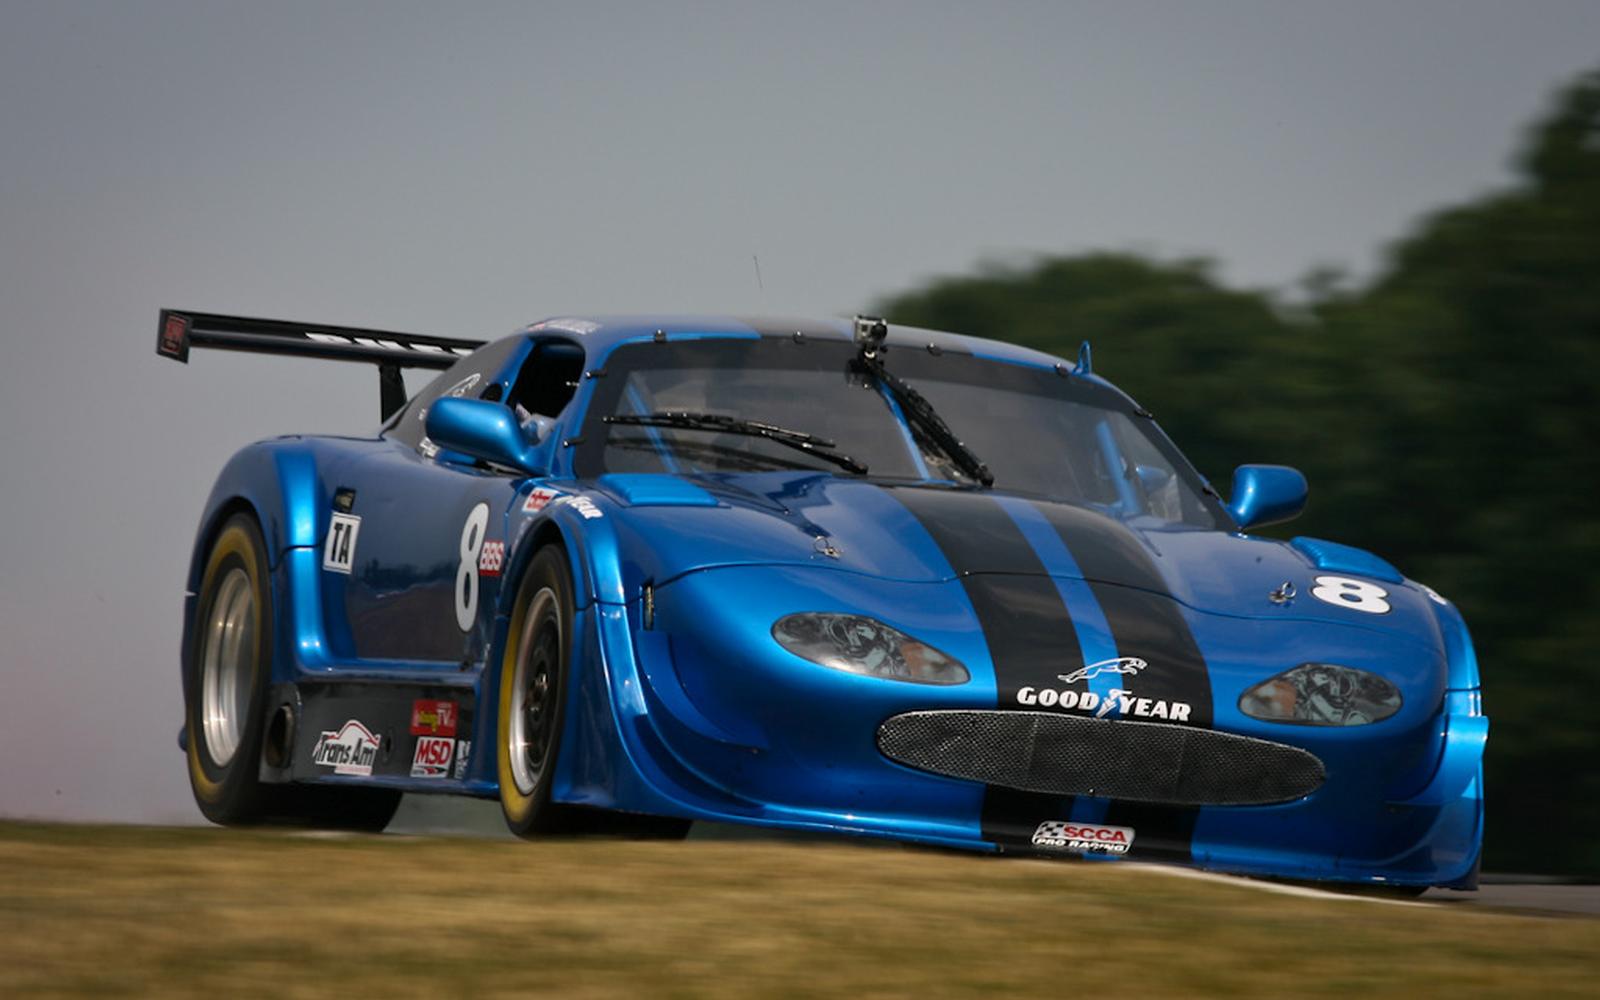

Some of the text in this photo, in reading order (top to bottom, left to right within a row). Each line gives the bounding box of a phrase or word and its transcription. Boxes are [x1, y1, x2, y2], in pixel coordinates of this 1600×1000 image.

[330, 522, 352, 564] TA
[479, 541, 504, 571] BBS
[455, 502, 489, 632] 8
[1312, 575, 1391, 615] 8
[315, 735, 374, 766] Trans Am
[415, 739, 451, 765] MSD
[1036, 838, 1125, 852] PRO RACING
[1063, 826, 1127, 843] SCCA
